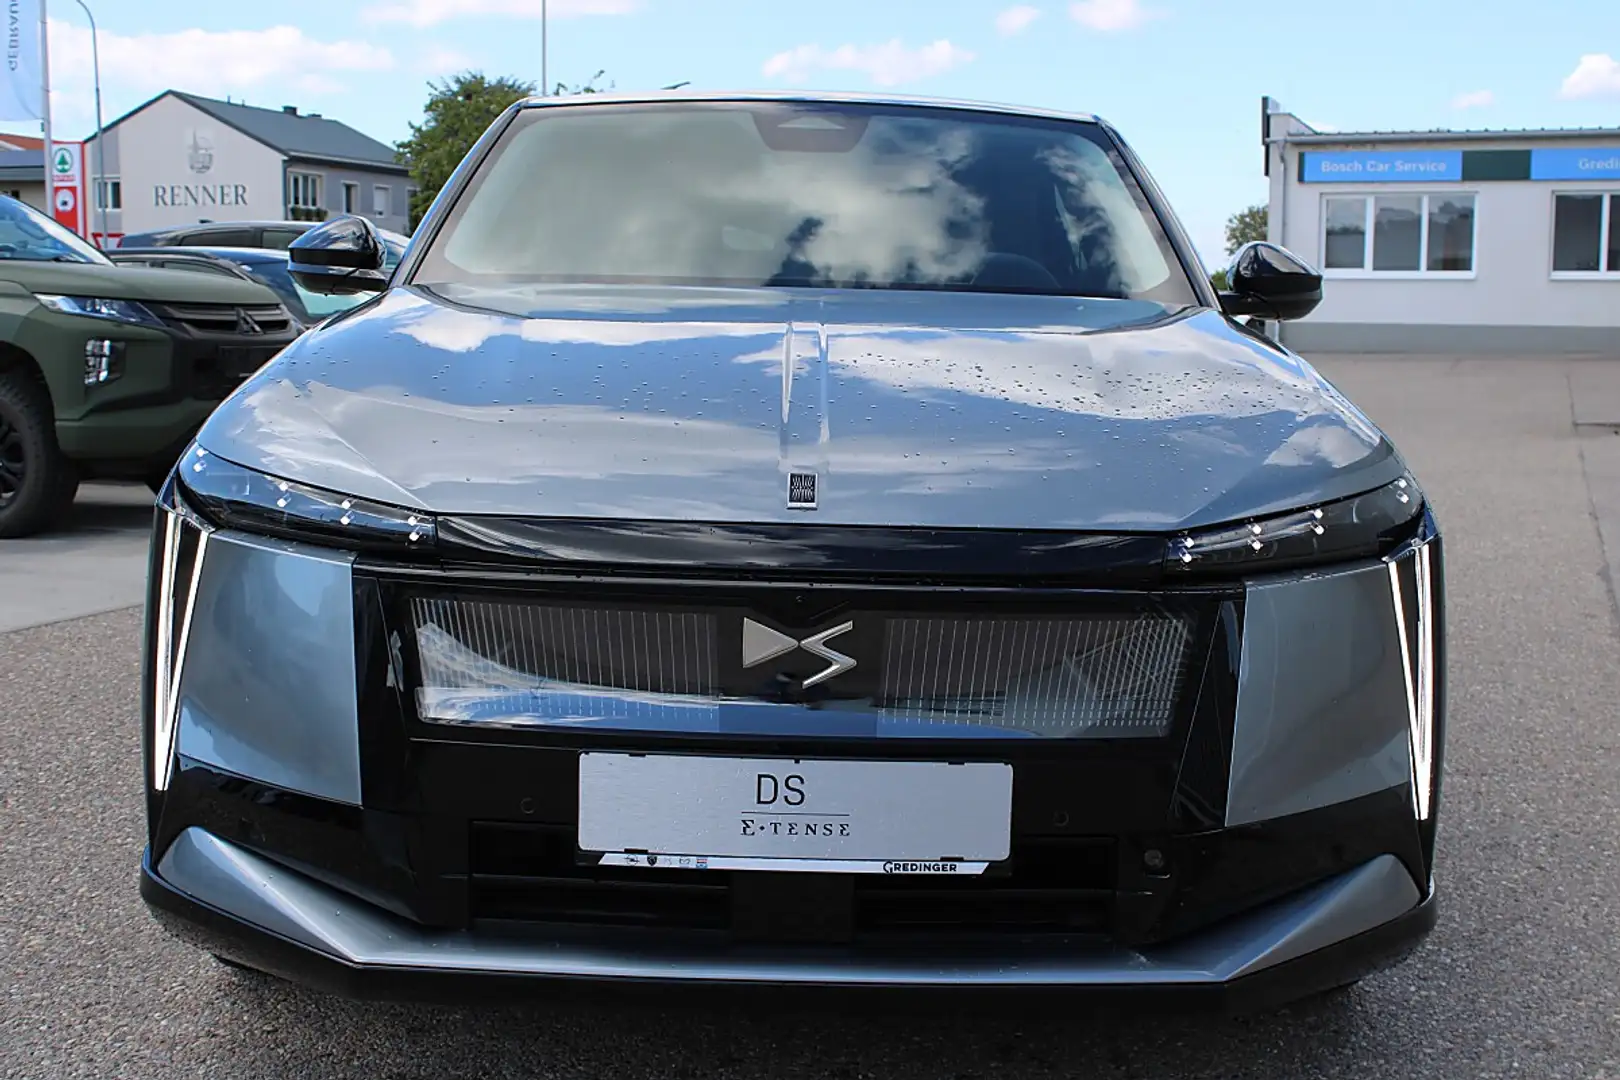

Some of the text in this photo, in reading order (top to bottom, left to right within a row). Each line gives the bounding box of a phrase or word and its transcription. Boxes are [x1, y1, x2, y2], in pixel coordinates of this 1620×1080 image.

[1321, 160, 1447, 173] Bosch Car Service
[153, 183, 249, 207] RENNER
[756, 773, 806, 806] DS
[882, 861, 958, 874] GREDINGER
